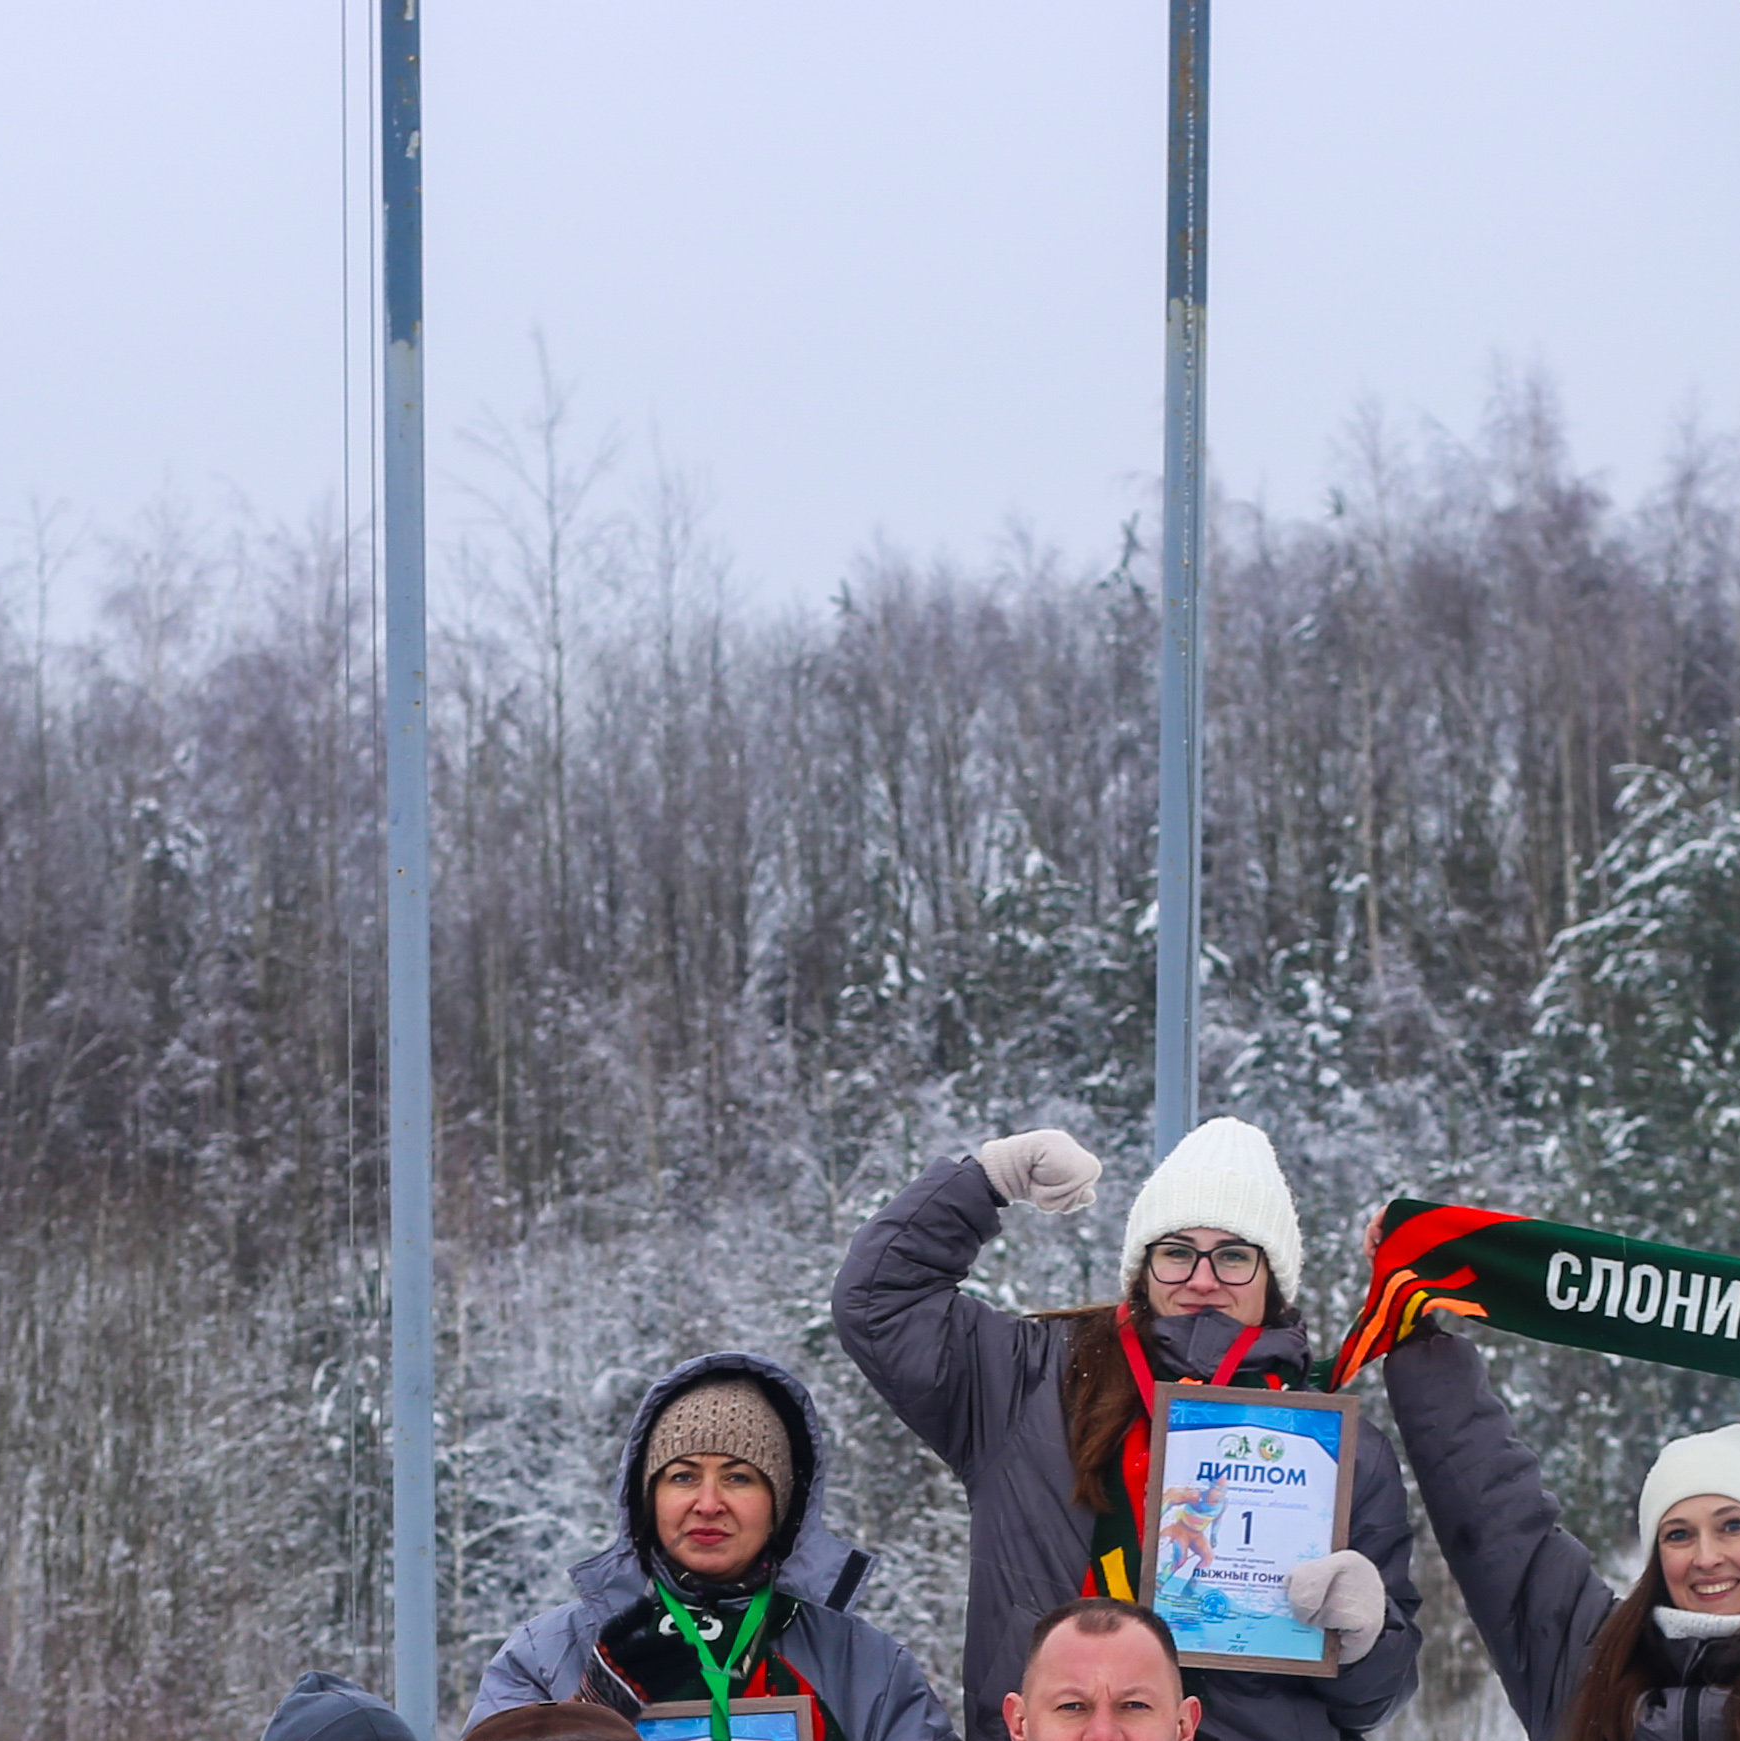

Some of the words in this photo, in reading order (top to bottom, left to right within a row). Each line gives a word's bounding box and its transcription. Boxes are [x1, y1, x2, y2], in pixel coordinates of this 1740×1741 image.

[1196, 1461, 1307, 1486] ДИПЛОМ
[1241, 1511, 1253, 1545] 1
[1192, 1568, 1249, 1581] ЛЫЖНЫЕ
[1252, 1572, 1286, 1583] ГОНК
